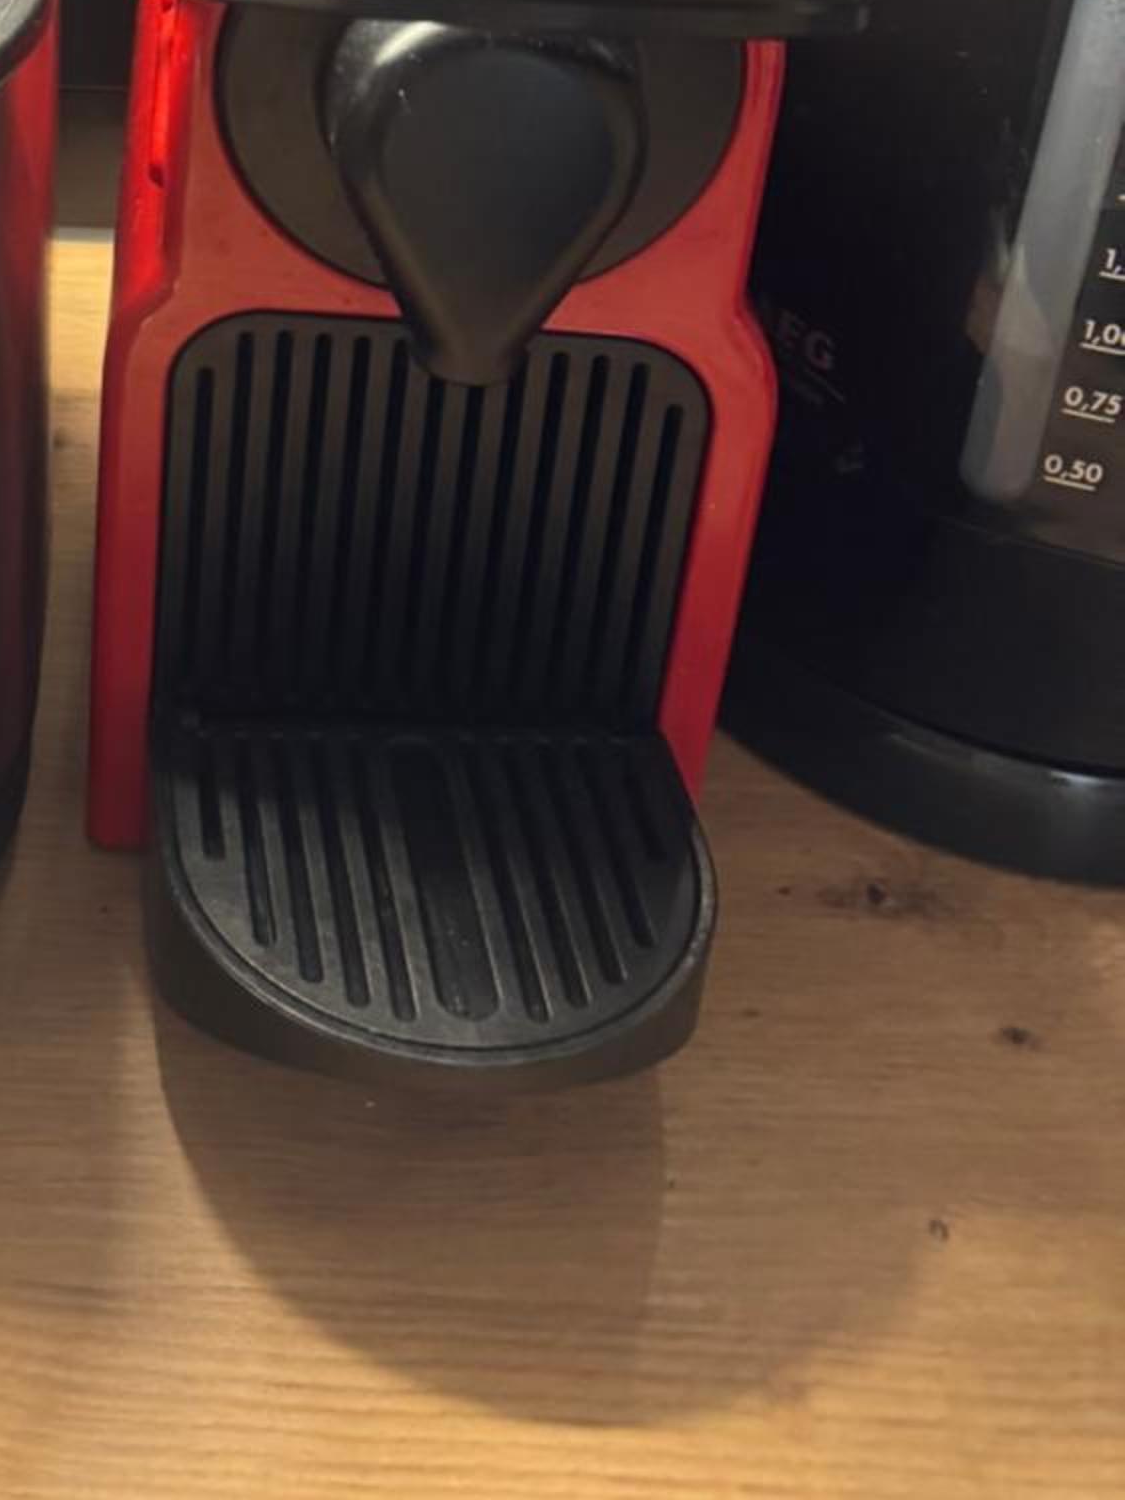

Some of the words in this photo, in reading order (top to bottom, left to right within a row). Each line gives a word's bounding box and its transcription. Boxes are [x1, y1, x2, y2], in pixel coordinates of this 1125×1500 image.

[1105, 247, 1125, 274] 1,
[1084, 318, 1125, 347] 1,0
[1064, 385, 1123, 416] 0,75
[1043, 453, 1103, 484] 0,50
